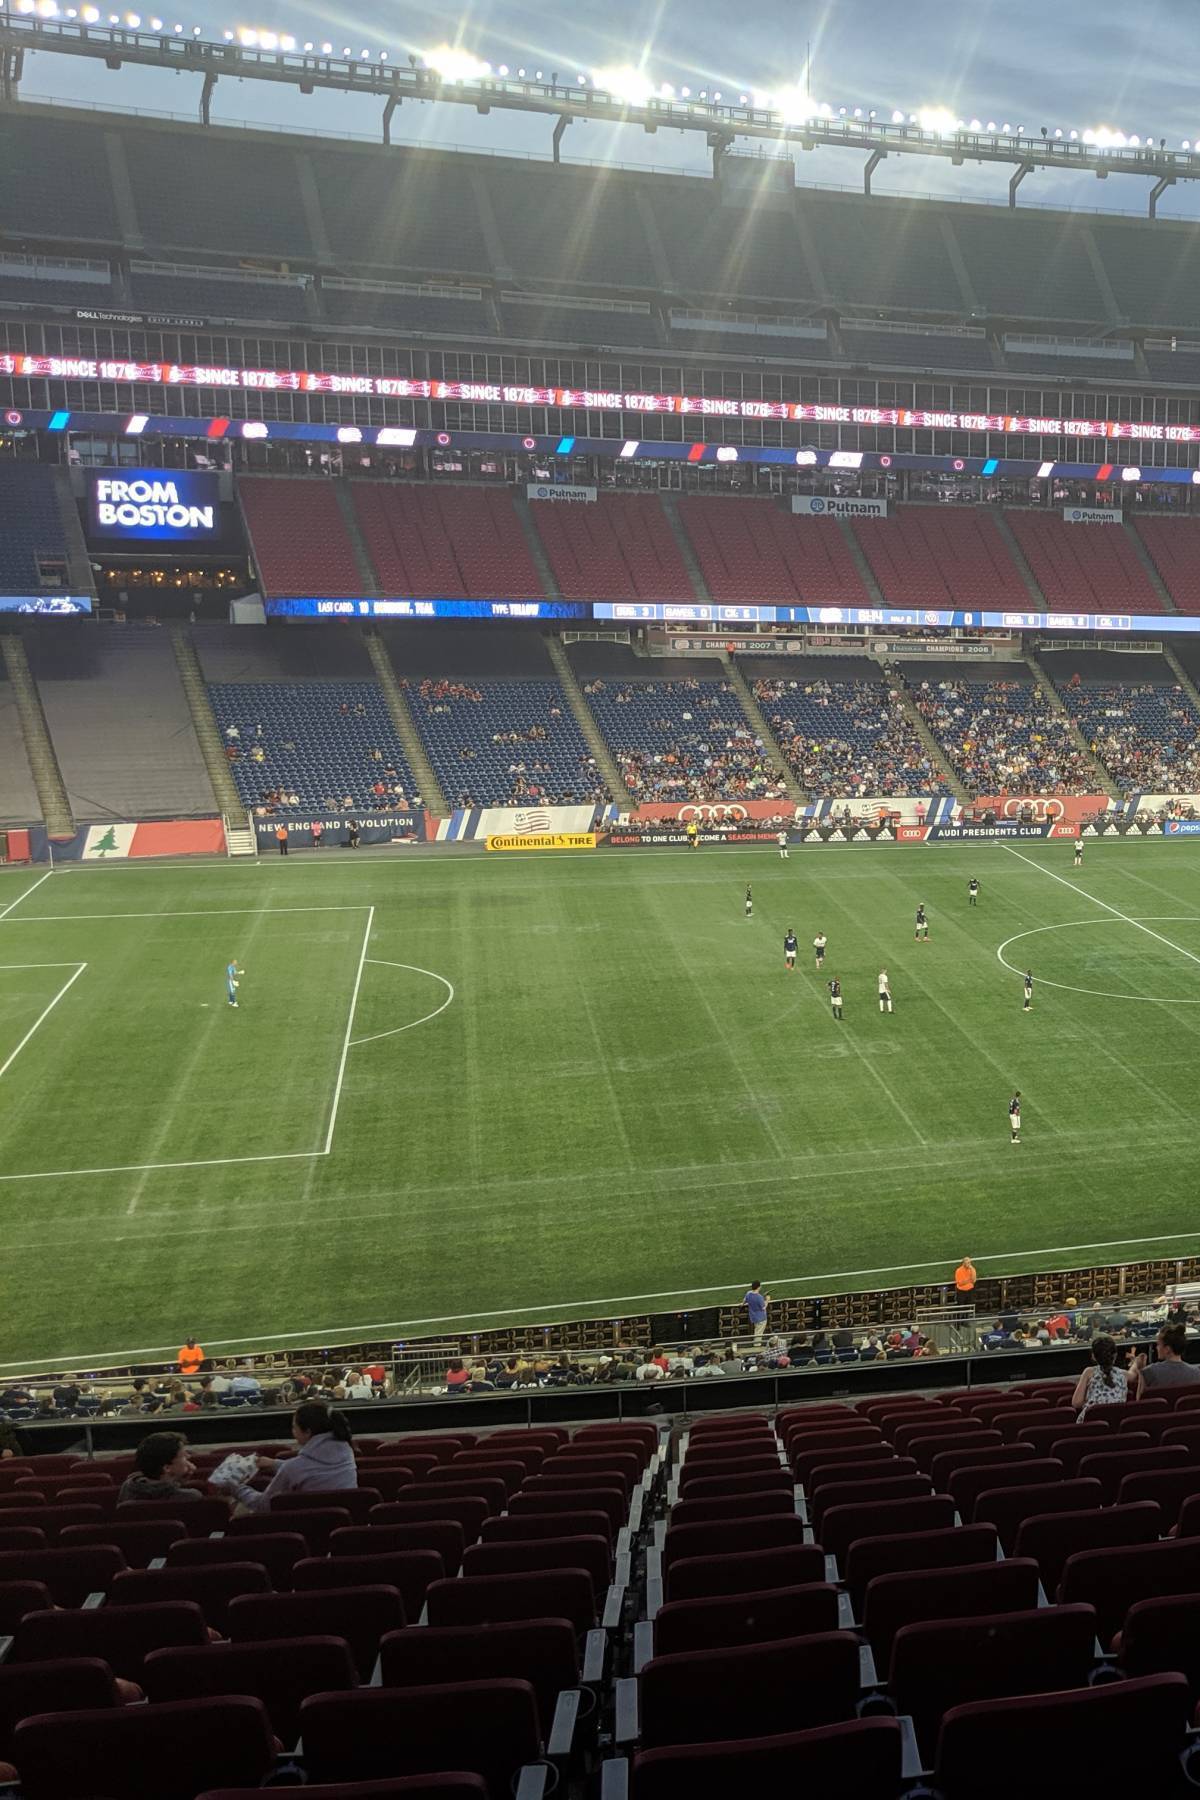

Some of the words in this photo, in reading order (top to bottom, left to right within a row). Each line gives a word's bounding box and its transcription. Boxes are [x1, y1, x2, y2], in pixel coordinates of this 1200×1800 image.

[54, 360, 97, 377] SINCE
[199, 368, 239, 385] SINCE
[333, 376, 373, 393] SINCE
[462, 384, 500, 400] SINCE
[587, 392, 622, 408] SINCE
[703, 399, 738, 415] SINCE
[815, 406, 849, 421] SINCE
[923, 413, 957, 427] SINCE
[1029, 418, 1061, 433] SINCE
[1131, 424, 1163, 439] SINCE
[97, 480, 178, 503] FROM
[550, 489, 587, 499] Putnam
[827, 501, 881, 514] Putnam
[98, 504, 213, 528] BOSTON
[1082, 511, 1114, 520] Putnam
[317, 601, 333, 613] LAST
[705, 641, 746, 649] CHAMONS
[926, 645, 964, 653] CHAMPIONS
[259, 823, 283, 832] NEW
[345, 818, 414, 829] RVOLUTION
[938, 828, 960, 837] AUDI
[962, 827, 1018, 837] PRESIDENTS
[1020, 826, 1042, 836] CLUB
[491, 835, 557, 849] Continental
[568, 837, 593, 845] TIRE
